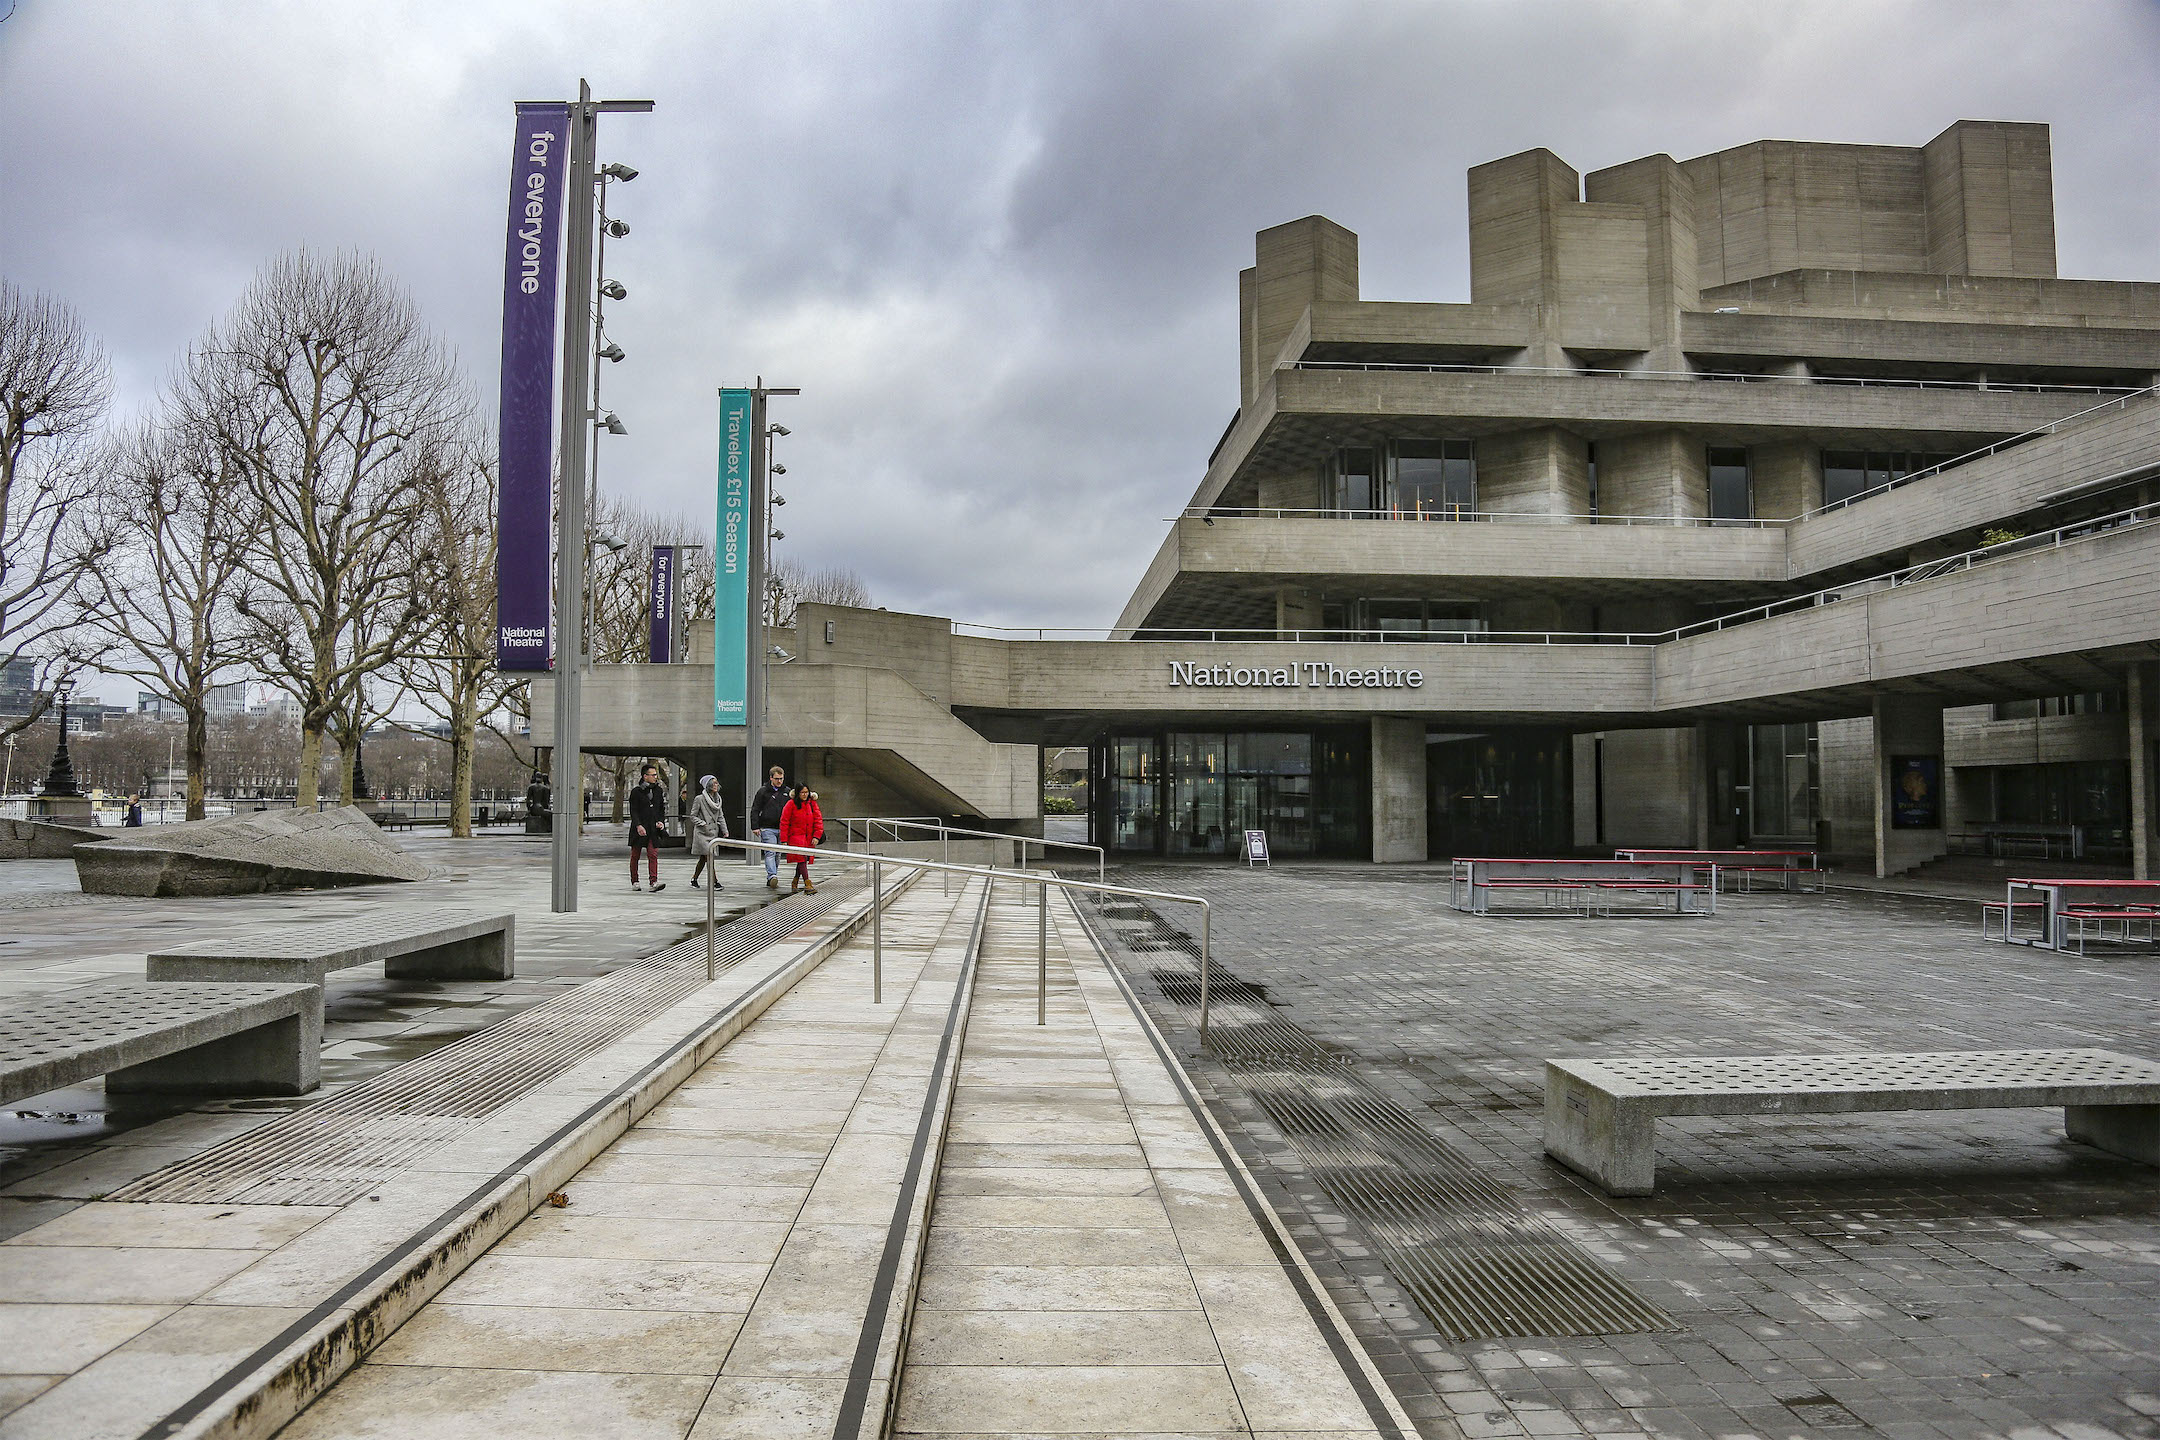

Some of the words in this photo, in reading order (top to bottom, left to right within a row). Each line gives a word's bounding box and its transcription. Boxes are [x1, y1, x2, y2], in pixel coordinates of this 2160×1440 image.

[531, 131, 555, 166] for
[519, 172, 545, 294] everyone
[727, 409, 743, 475] Travelex
[726, 478, 742, 508] £15
[725, 511, 741, 574] Season
[659, 556, 668, 571] for
[655, 573, 666, 619] everyone
[501, 637, 543, 647] Theatre
[502, 626, 545, 637] National
[1169, 660, 1301, 688] National
[1303, 661, 1424, 688] Theatre
